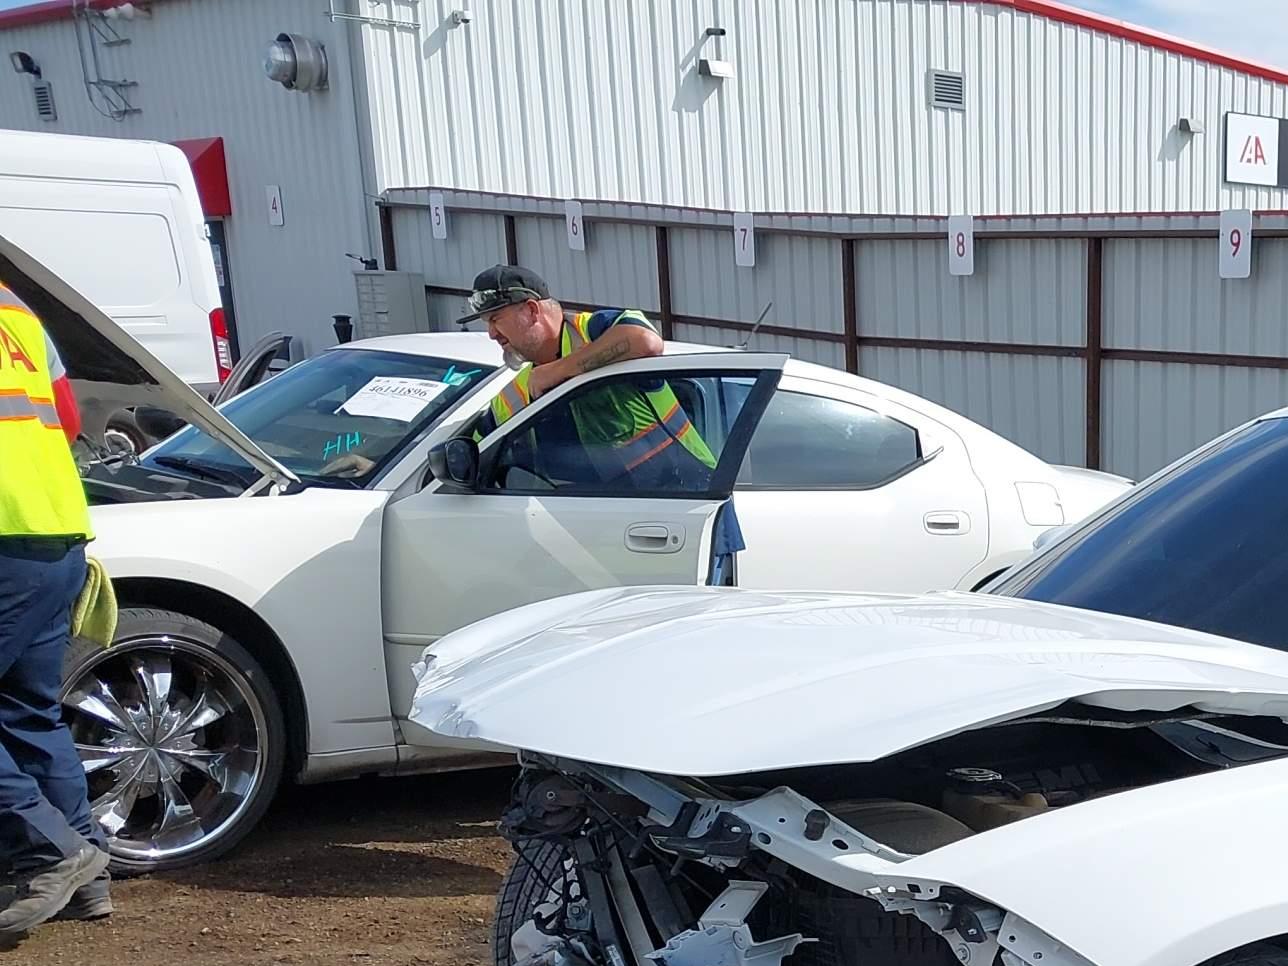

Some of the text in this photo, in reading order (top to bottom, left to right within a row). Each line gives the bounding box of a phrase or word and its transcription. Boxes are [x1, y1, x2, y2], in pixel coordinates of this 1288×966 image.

[271, 200, 278, 214] 4
[434, 206, 441, 226] 5
[571, 216, 578, 236] 6
[740, 228, 749, 251] 7
[956, 232, 966, 258] 8
[1230, 229, 1242, 258] 9
